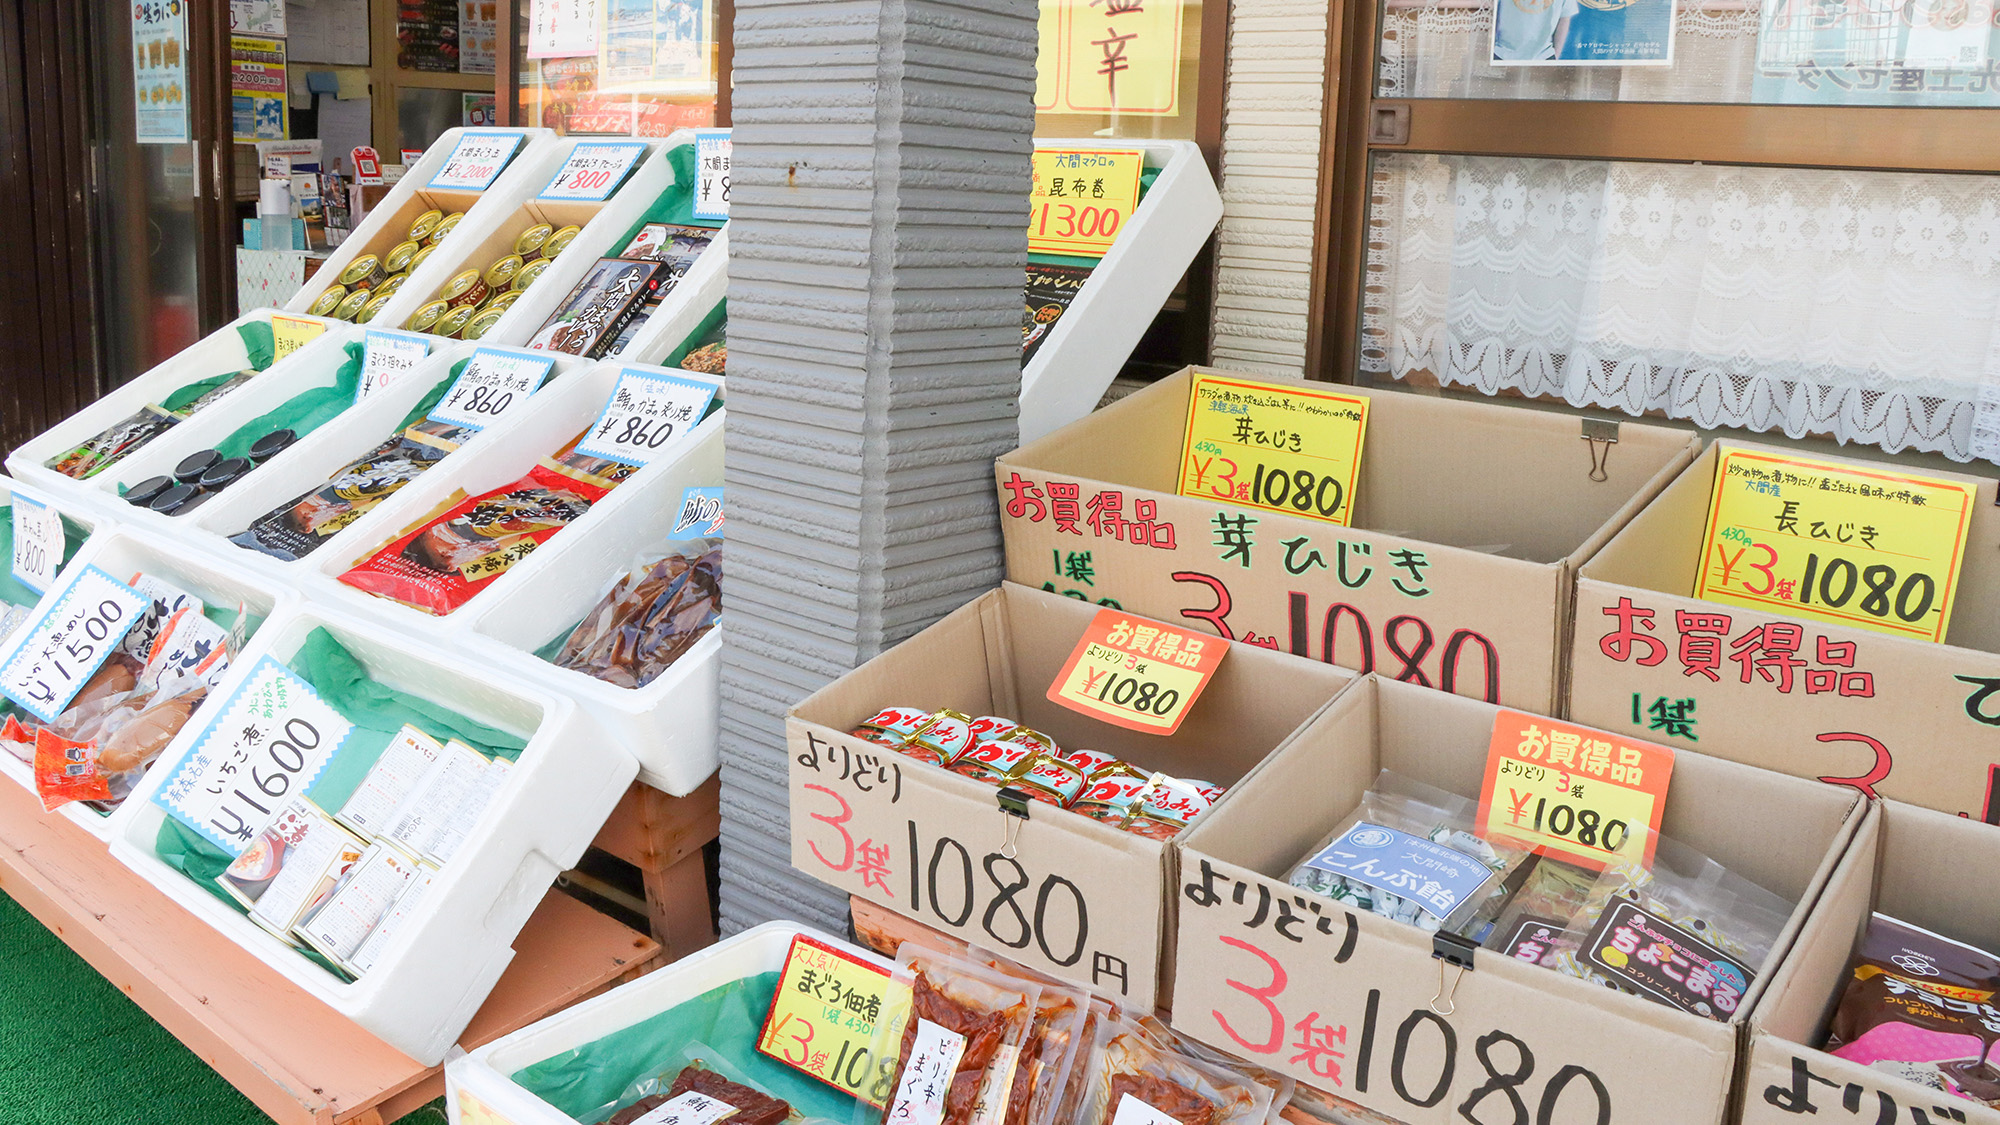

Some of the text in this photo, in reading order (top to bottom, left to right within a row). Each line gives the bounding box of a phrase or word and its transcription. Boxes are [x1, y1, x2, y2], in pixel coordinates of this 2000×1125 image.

[1049, 177, 1106, 198] 昆布巻
[1056, 153, 1115, 168] 大間マグロの
[1194, 441, 1222, 456] 430円
[1233, 416, 1302, 453] 芽ひじき
[1002, 473, 1177, 550] お買得品
[1745, 479, 1781, 498] 大間産
[1721, 526, 1753, 547] 430円
[1774, 500, 1879, 549] 長ひじき
[1051, 549, 1096, 586] 1袋
[1210, 511, 1433, 598] 芽ひじき
[1086, 644, 1147, 675] よりどり 3袋
[1106, 620, 1205, 669] お買得品
[1599, 597, 1875, 698] お買得品
[1080, 665, 1179, 716] ¥1080
[1631, 692, 1698, 741] 1袋
[206, 723, 270, 794] いちご煮
[210, 718, 321, 842] ¥1600
[797, 731, 901, 804] よりどり
[1500, 760, 1585, 799] よりどり 3袋
[1517, 724, 1644, 786] お買得品
[803, 783, 895, 898] 3袋
[1507, 787, 1630, 853] ¥1080
[1321, 851, 1456, 911] こんぶ飴
[1184, 859, 1359, 963] よりどり
[793, 945, 840, 972] 大人気!!
[1610, 925, 1742, 1013] ちょこまる
[798, 969, 881, 1023] まぐろ佃煮
[1212, 934, 1348, 1087] 3袋
[897, 1053, 925, 1118] まぐろ
